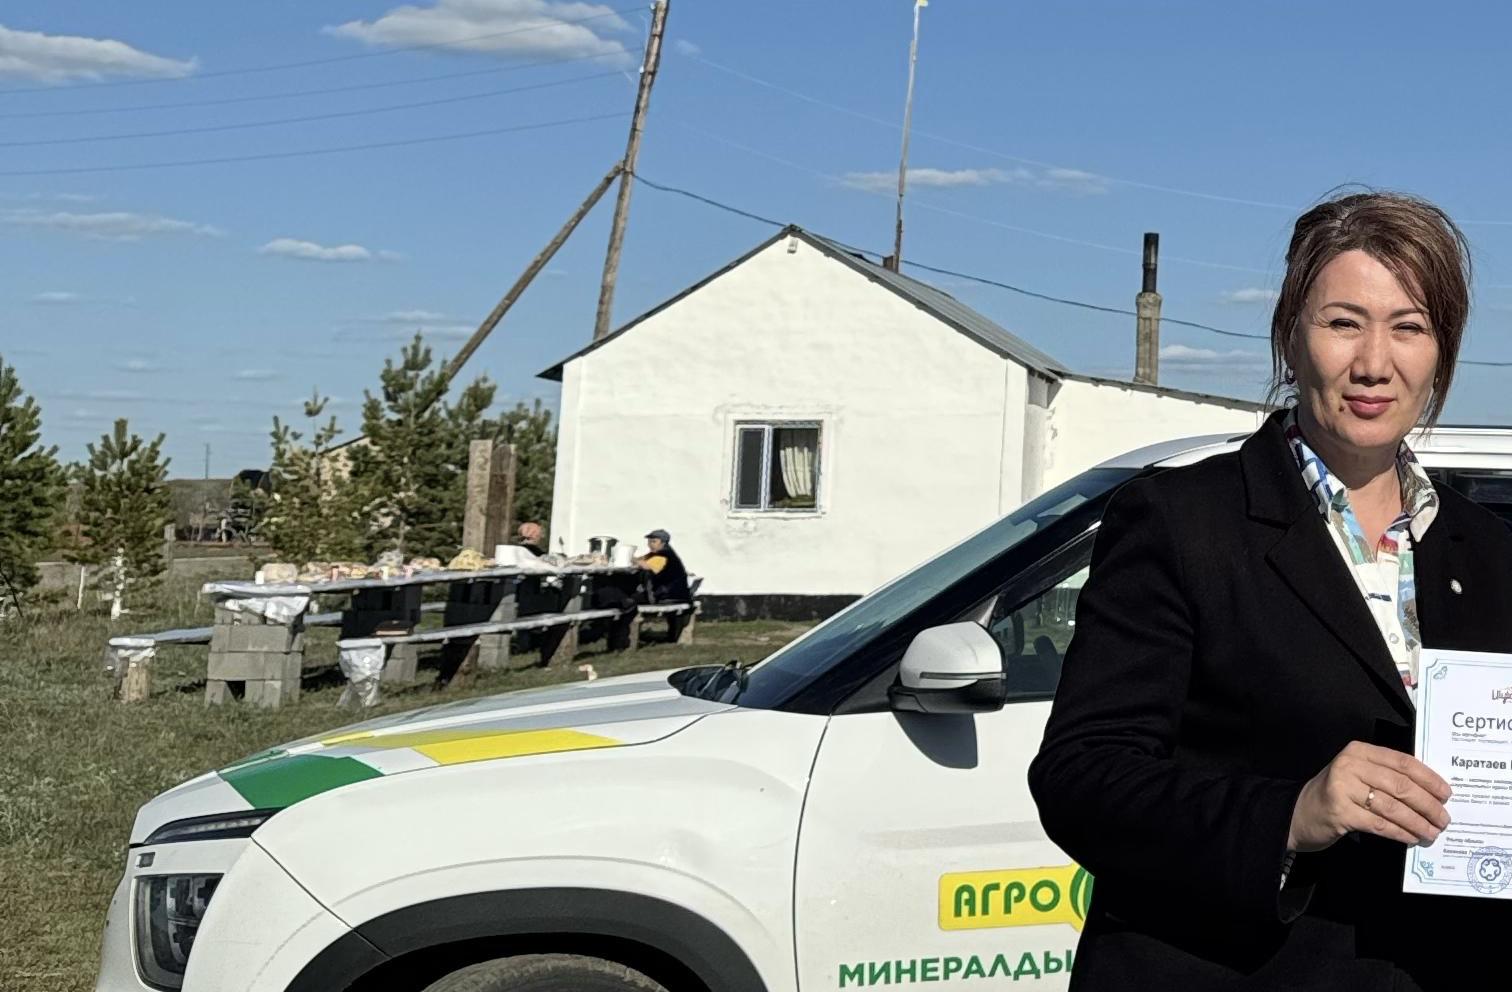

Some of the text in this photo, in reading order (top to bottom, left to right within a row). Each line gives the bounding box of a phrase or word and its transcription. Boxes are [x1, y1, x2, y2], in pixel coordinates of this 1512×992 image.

[1451, 755, 1507, 770] Каратаев
[953, 879, 1061, 918] АГРО
[838, 950, 1073, 988] МИНЕРАЛДЫ
